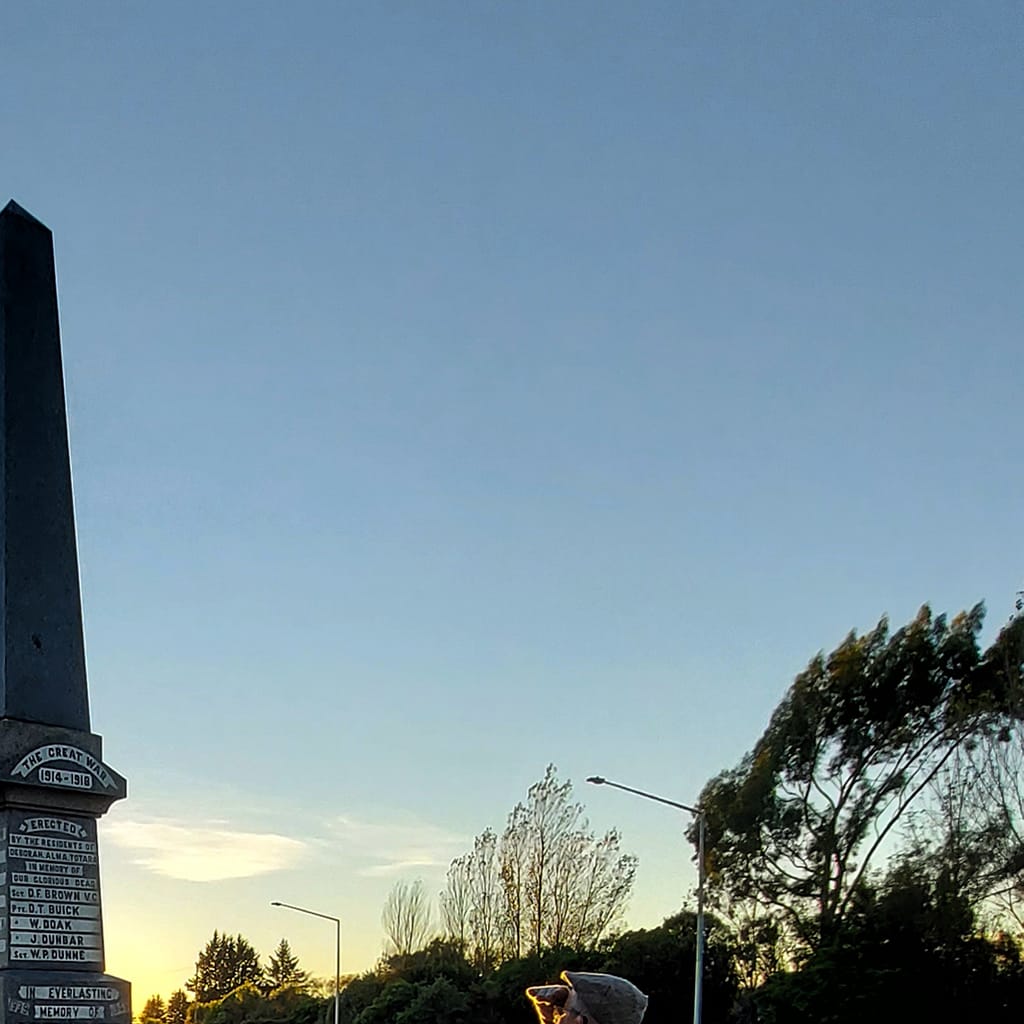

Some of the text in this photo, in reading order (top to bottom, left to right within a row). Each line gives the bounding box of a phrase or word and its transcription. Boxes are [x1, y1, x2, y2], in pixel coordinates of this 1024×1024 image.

[22, 747, 107, 780] THE GREAT WAR
[31, 819, 76, 834] ERECTED
[11, 835, 22, 844] BY
[24, 836, 39, 845] THE
[41, 838, 82, 850] RESIDENTS
[85, 843, 95, 851] OF
[29, 863, 80, 874] IN MEMORY OF
[13, 874, 29, 882] OUR
[33, 875, 69, 886] GLORIOUS
[45, 889, 80, 901] BROWN
[49, 904, 80, 916] BUICK
[43, 919, 72, 931] DOAK
[42, 934, 84, 946] DUNBAR
[51, 949, 85, 961] DUNNE
[26, 987, 112, 1000] IN EVERLASTING
[39, 1006, 80, 1018] MEMORY
[88, 1006, 100, 1018] OF
